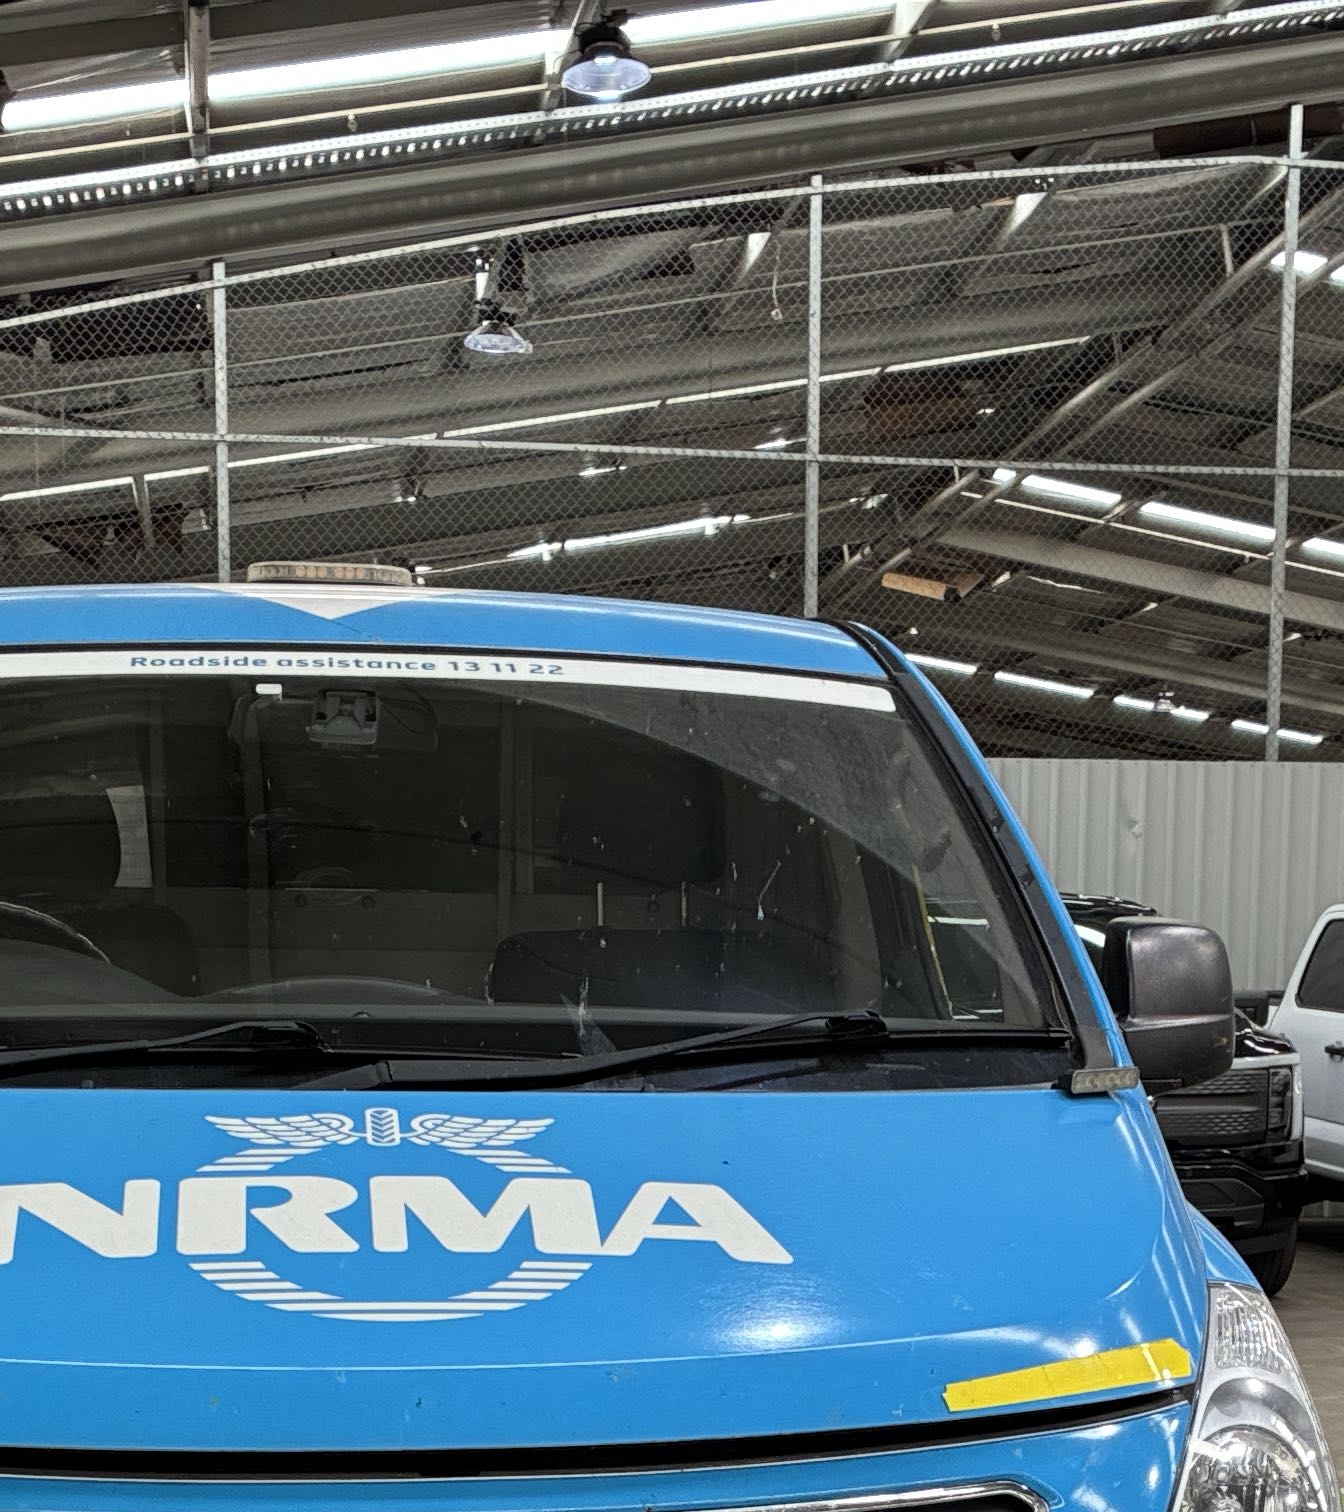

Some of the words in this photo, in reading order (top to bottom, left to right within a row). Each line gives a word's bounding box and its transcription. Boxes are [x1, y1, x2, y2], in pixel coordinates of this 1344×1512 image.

[130, 655, 268, 668] Roadside
[276, 656, 437, 672] assistance
[447, 661, 481, 673] 13
[490, 662, 518, 674] 11
[528, 663, 565, 676] 22
